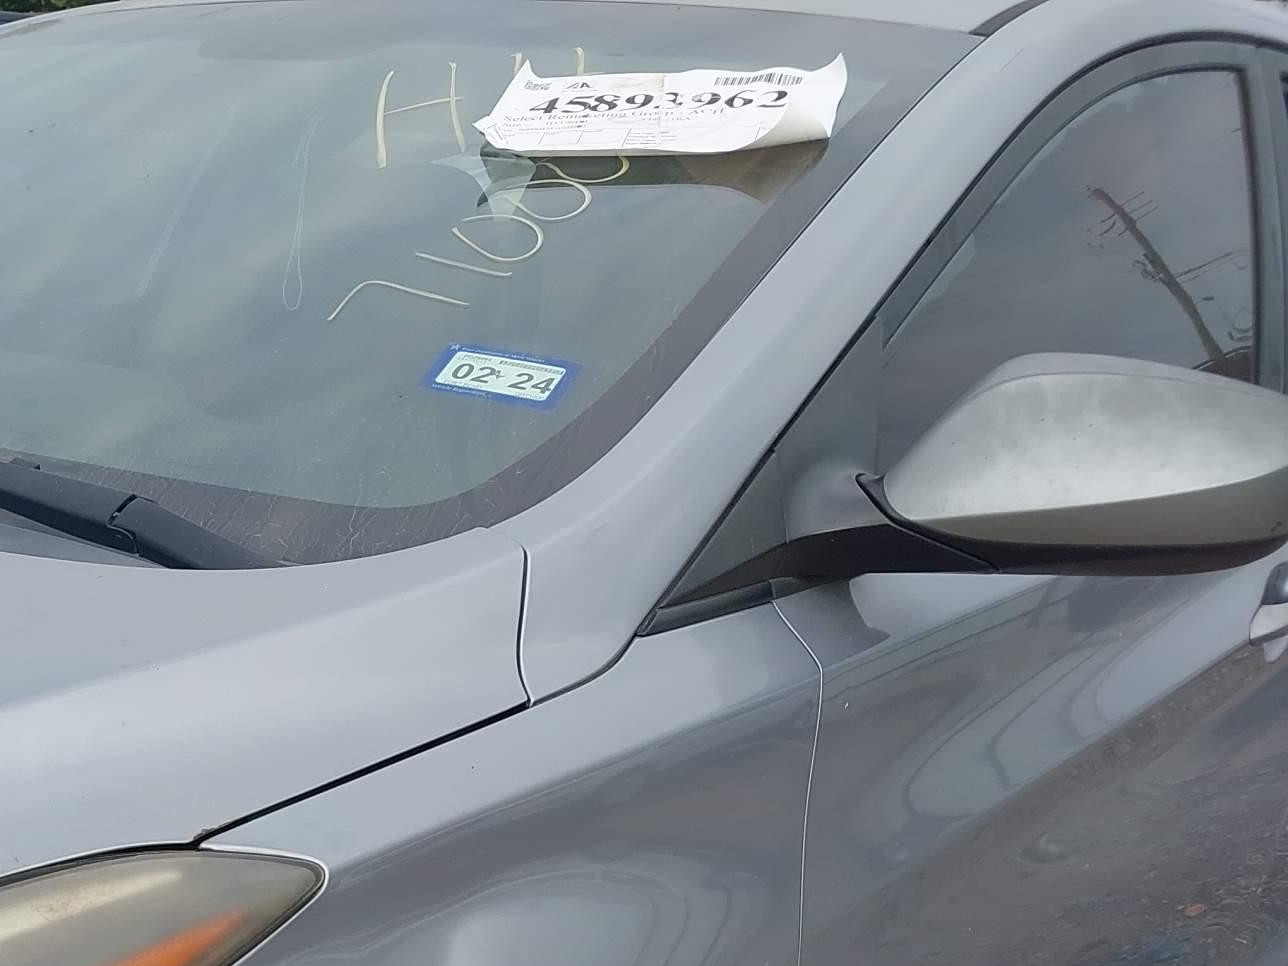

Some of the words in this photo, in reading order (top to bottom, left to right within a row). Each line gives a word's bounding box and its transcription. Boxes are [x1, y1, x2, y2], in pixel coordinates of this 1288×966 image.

[529, 89, 788, 115] 45893962
[452, 363, 495, 384] 02
[508, 373, 556, 395] 24
